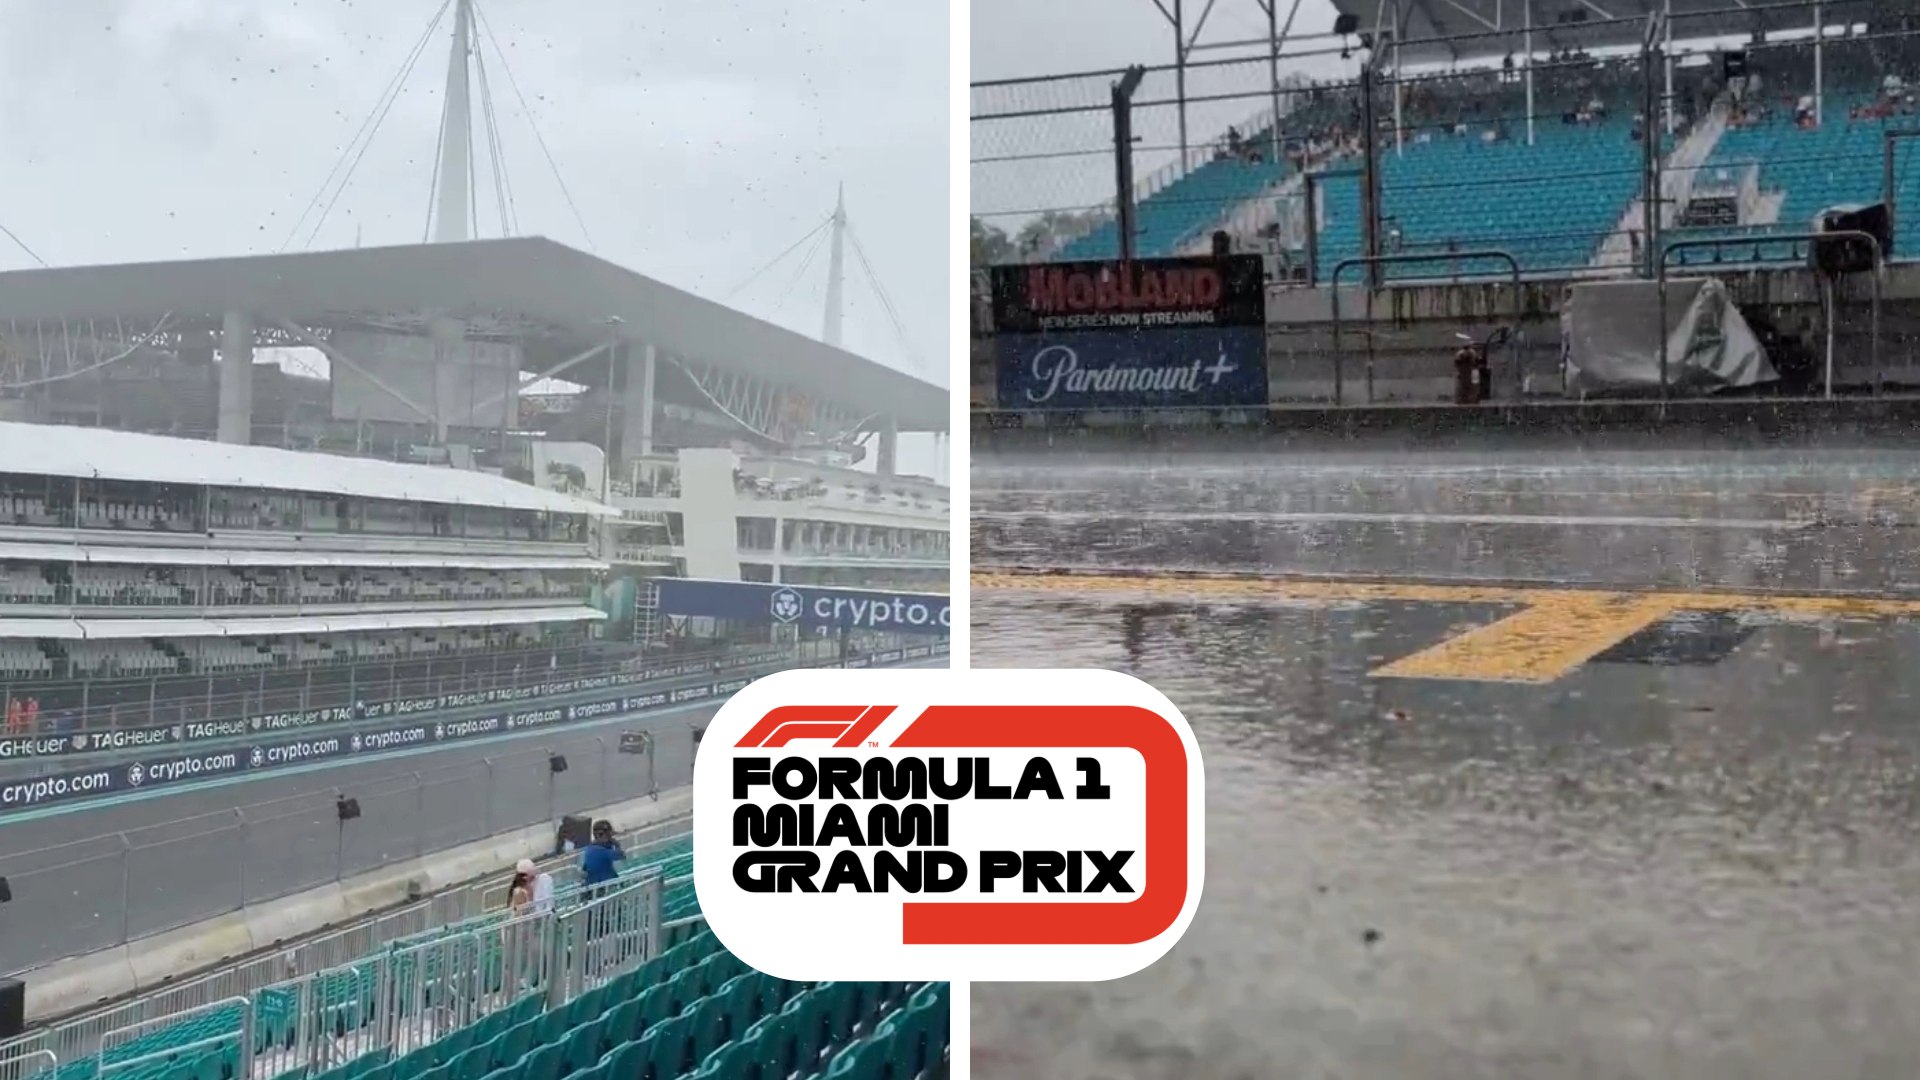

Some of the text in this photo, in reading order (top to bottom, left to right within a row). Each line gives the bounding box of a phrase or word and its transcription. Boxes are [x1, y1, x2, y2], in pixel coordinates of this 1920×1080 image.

[1039, 310, 1214, 328] NEW SERIES NOW STREAMING
[2, 772, 109, 803] crypto.com
[150, 752, 235, 779] crypto.com
[268, 738, 339, 761] crypto.com
[365, 727, 425, 747] crypto.com
[447, 718, 498, 736] crypto.com
[516, 710, 560, 726] crypto.com
